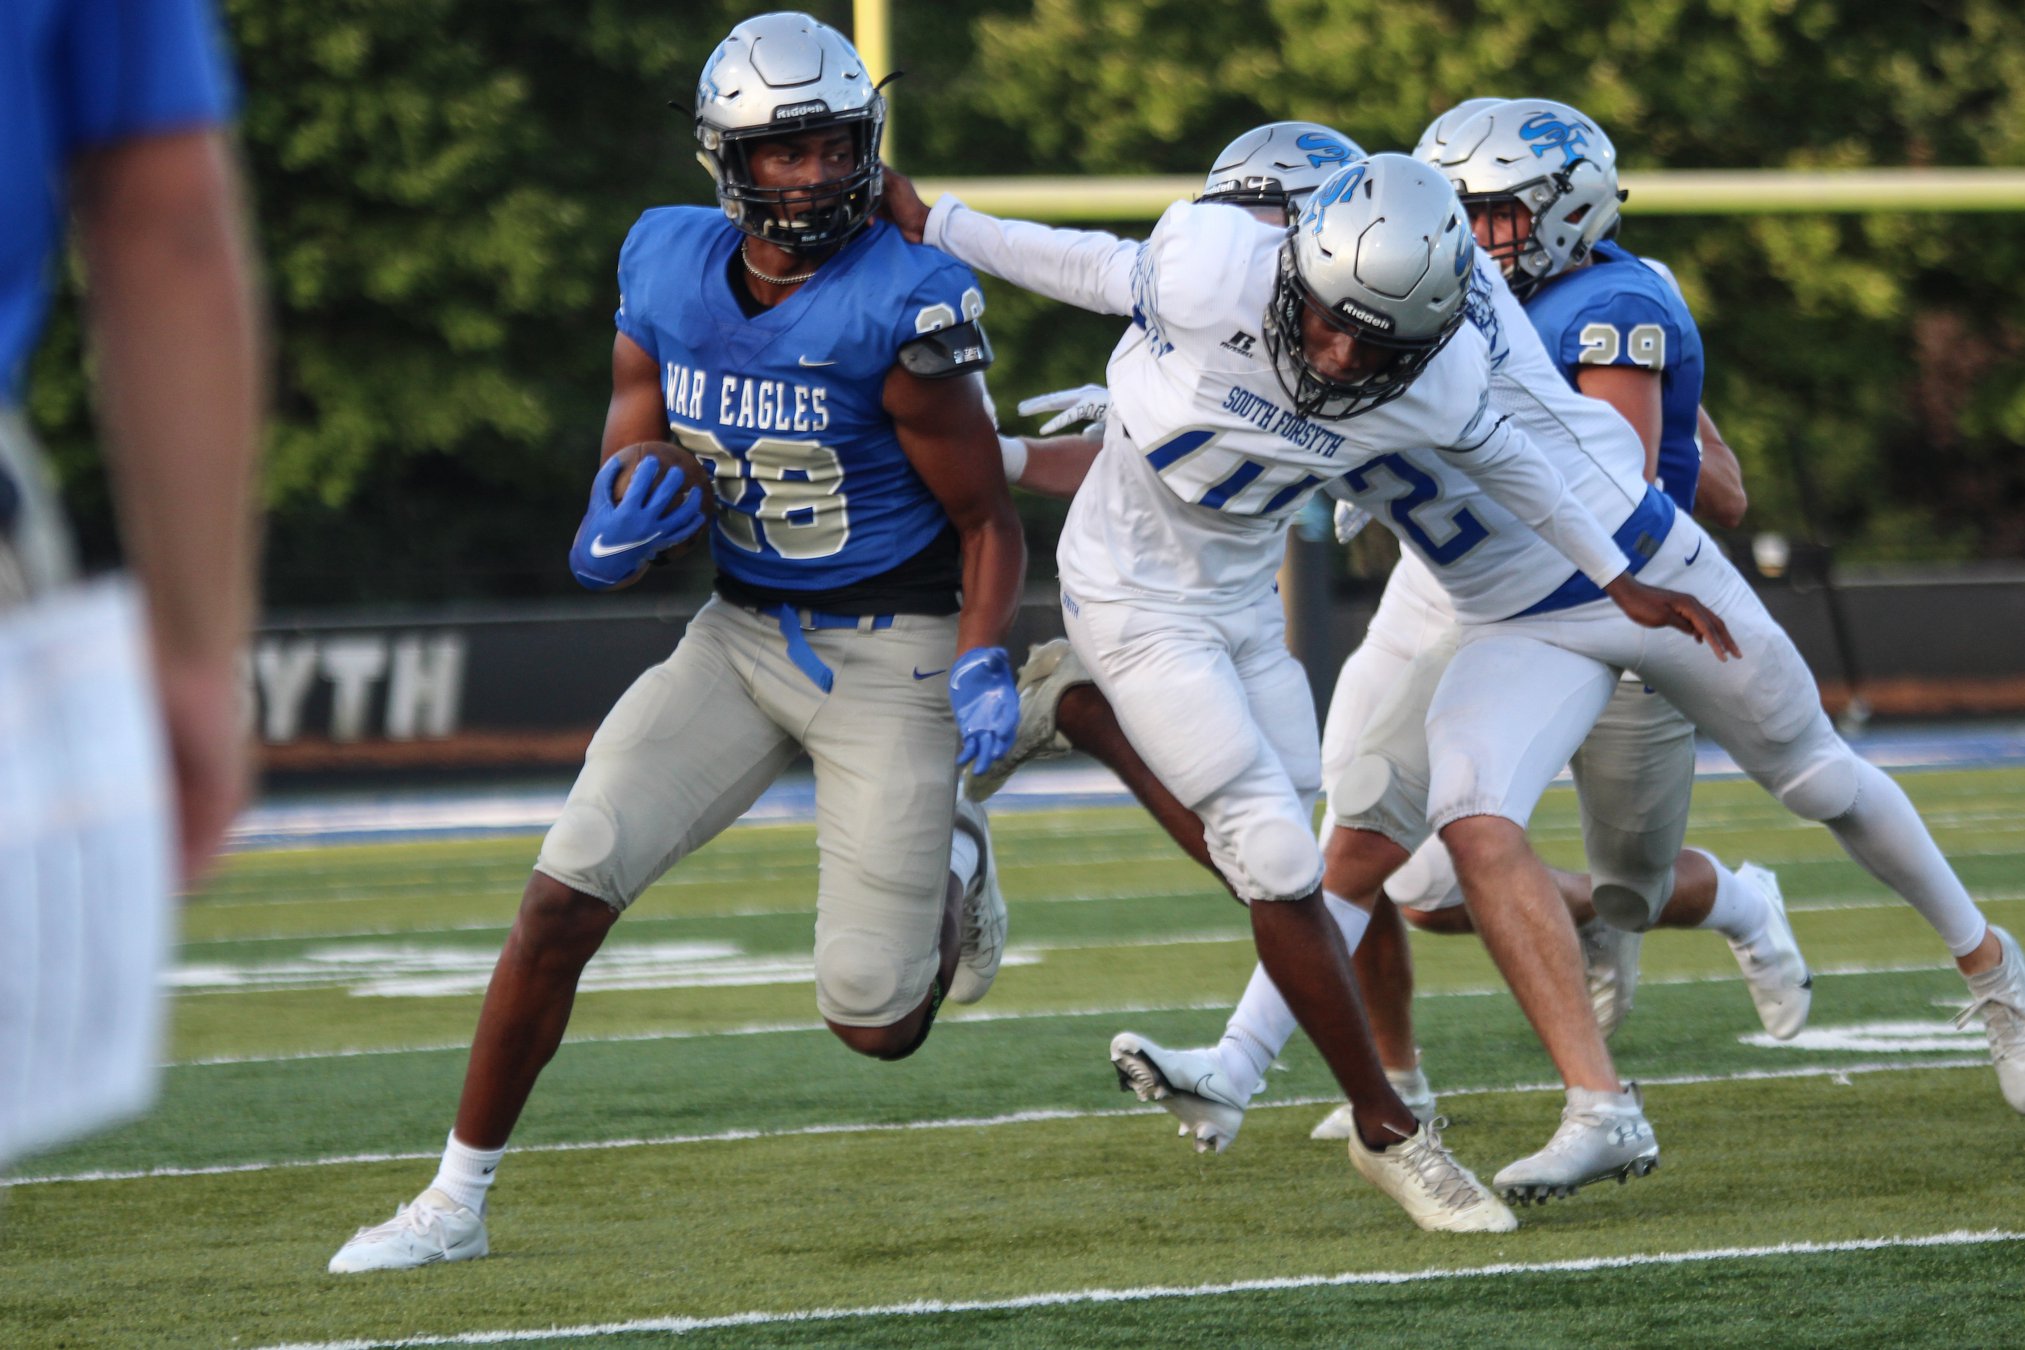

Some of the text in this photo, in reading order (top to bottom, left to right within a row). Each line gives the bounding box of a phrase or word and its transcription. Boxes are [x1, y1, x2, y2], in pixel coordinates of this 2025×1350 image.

[1342, 301, 1390, 330] Riddell
[1578, 322, 1666, 371] 29
[666, 361, 830, 432] WAR EAGLES
[1222, 385, 1347, 459] SOUTH FORSYTH
[240, 633, 466, 743] YTH
